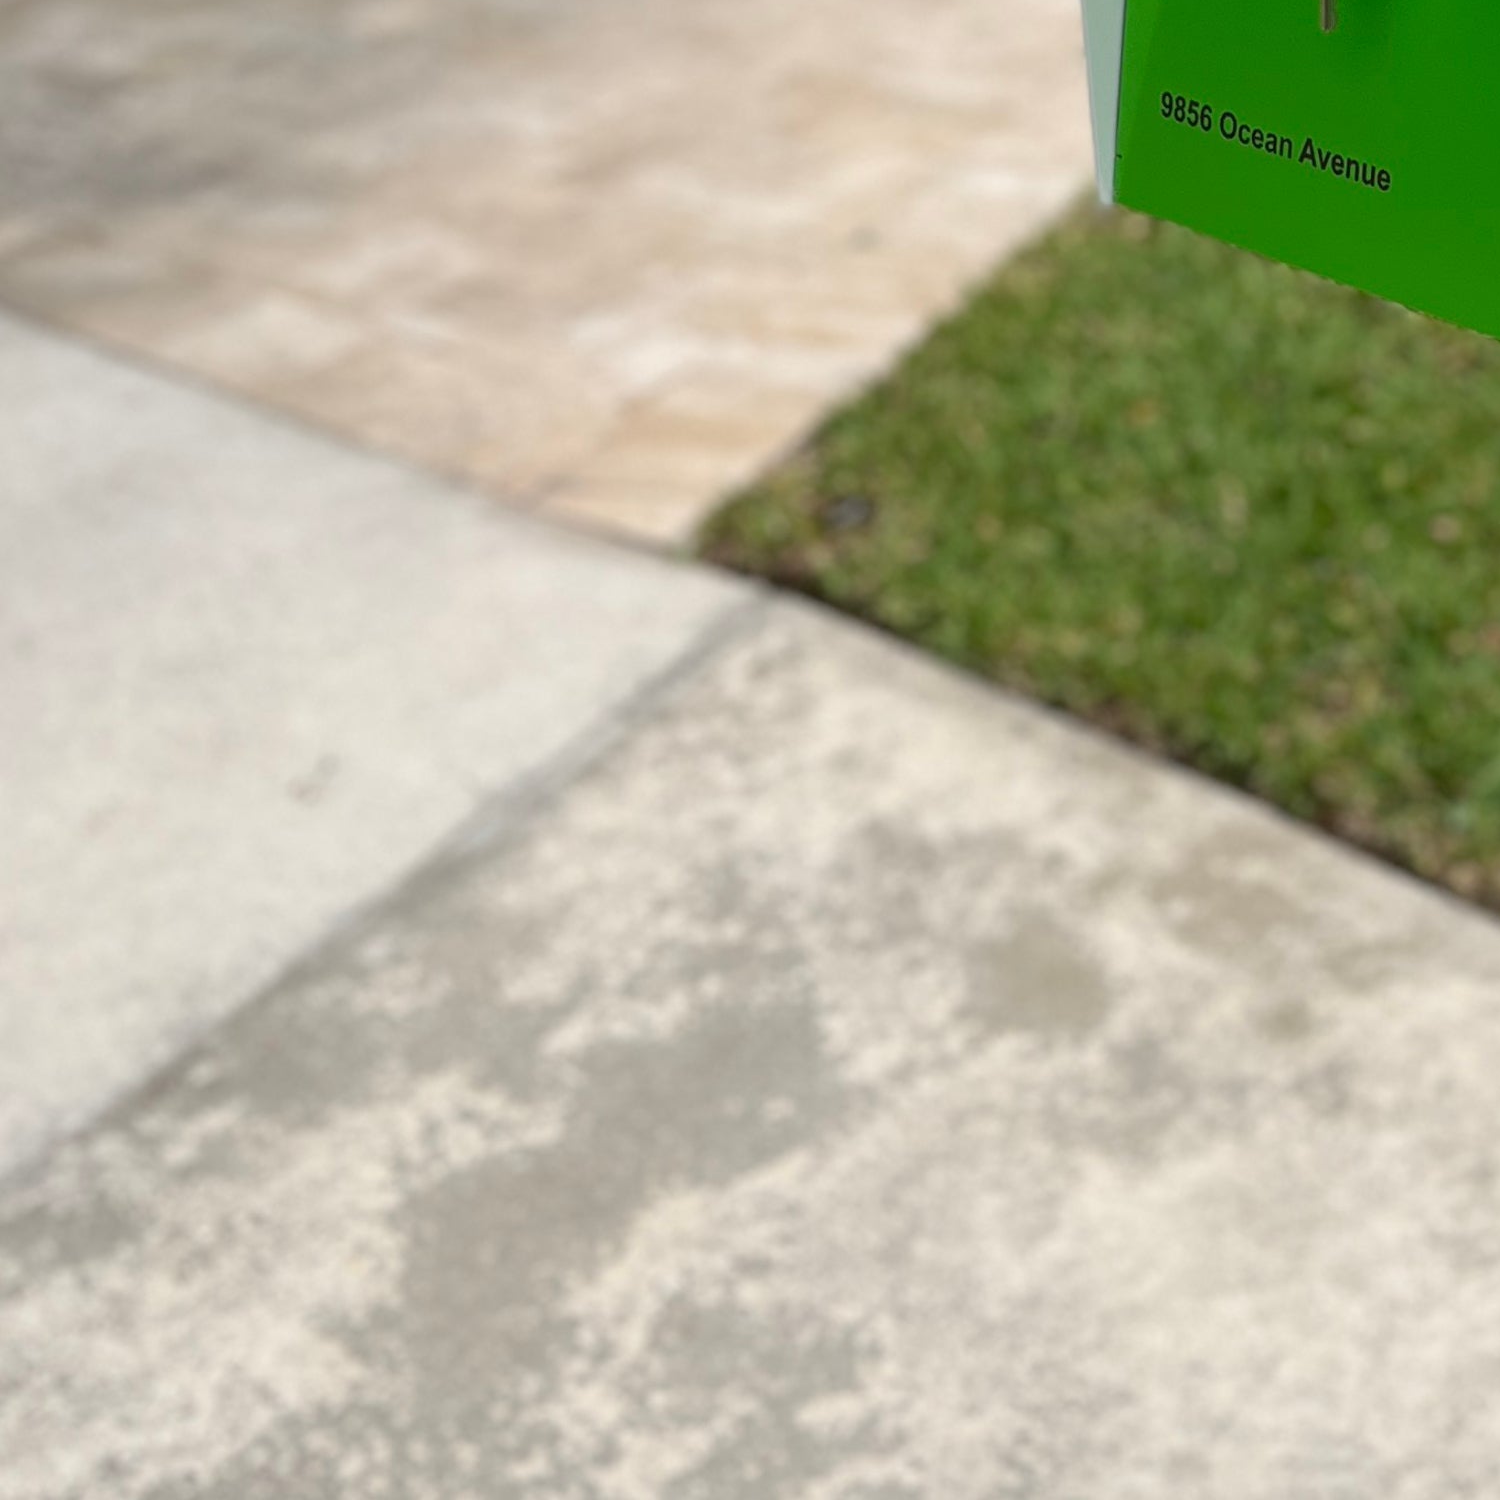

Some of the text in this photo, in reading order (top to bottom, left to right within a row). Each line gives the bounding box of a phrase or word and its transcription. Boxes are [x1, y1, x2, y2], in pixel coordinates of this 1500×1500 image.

[1160, 91, 1392, 191] 9856 Ocean Avenue
